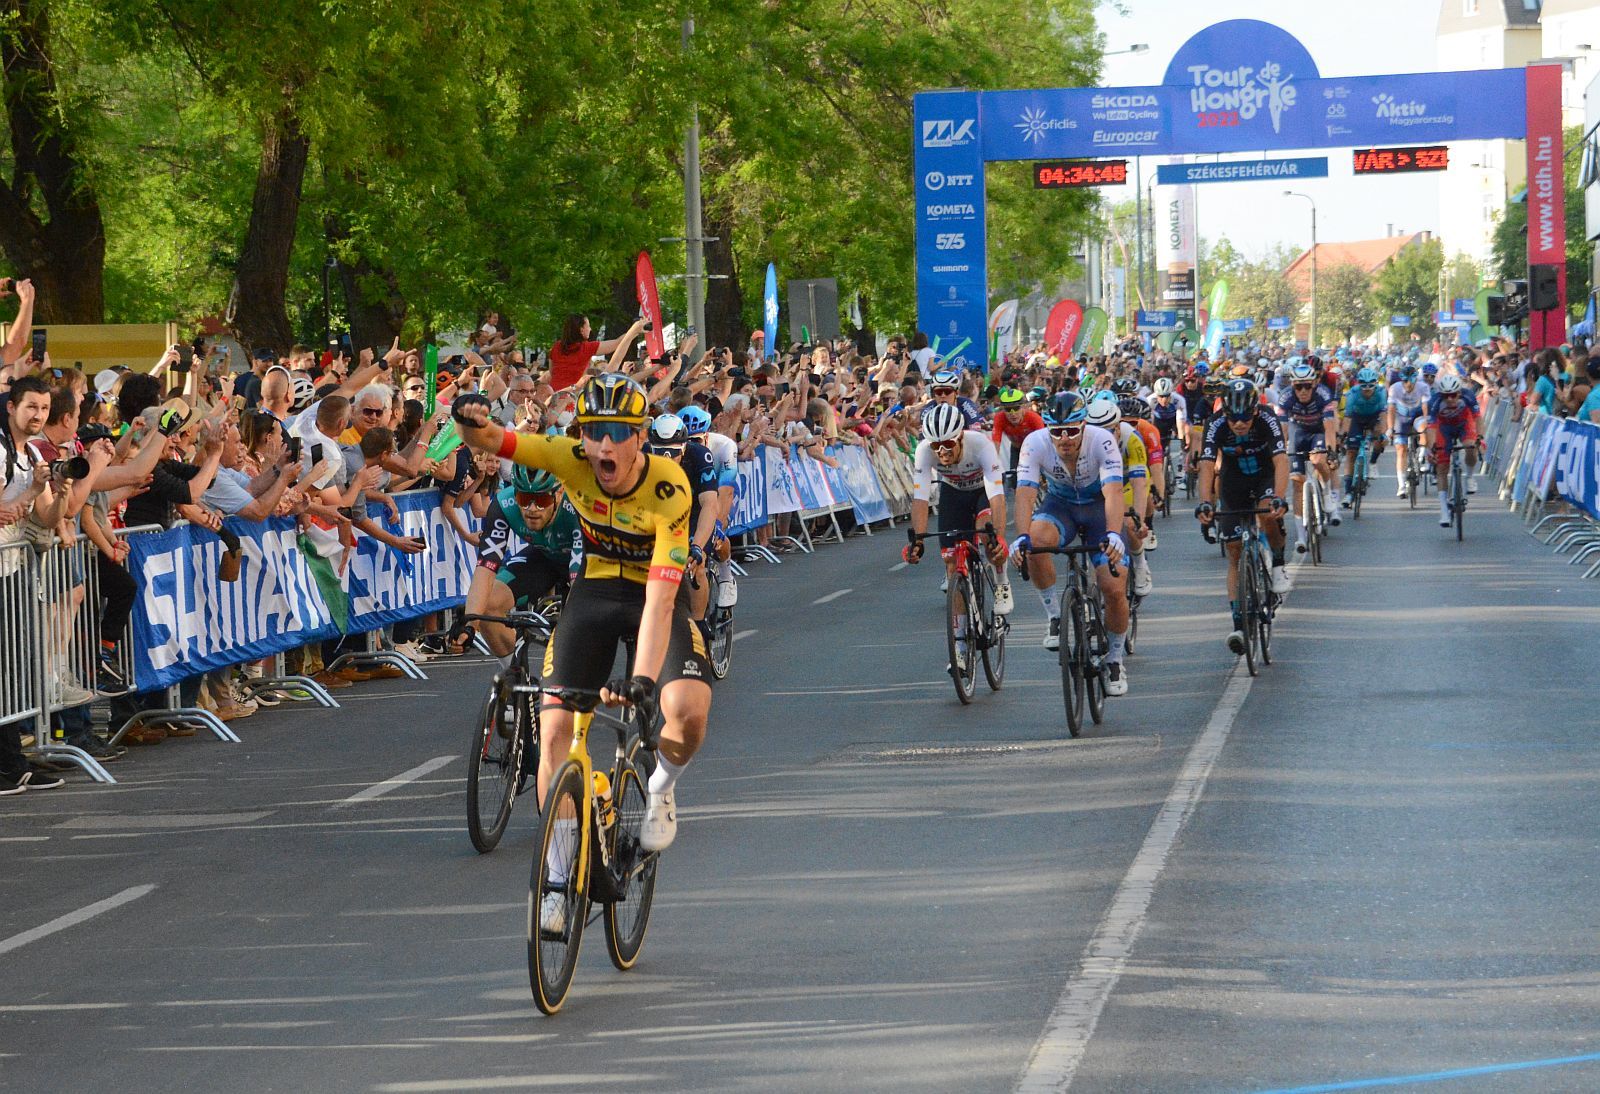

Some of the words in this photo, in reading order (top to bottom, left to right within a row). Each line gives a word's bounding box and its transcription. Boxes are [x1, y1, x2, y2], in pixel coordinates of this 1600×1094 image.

[1187, 64, 1253, 87] Tour
[1092, 95, 1158, 108] ŠKODA
[1030, 119, 1077, 130] Cofidis
[1093, 130, 1159, 144] Europcar
[1187, 162, 1298, 180] SZÉKESFEHÉRVÁR
[947, 174, 973, 186] NTT
[1535, 136, 1553, 251] www.tdh.hu
[926, 204, 975, 216] KOMETA
[1170, 200, 1179, 250] KOMETA
